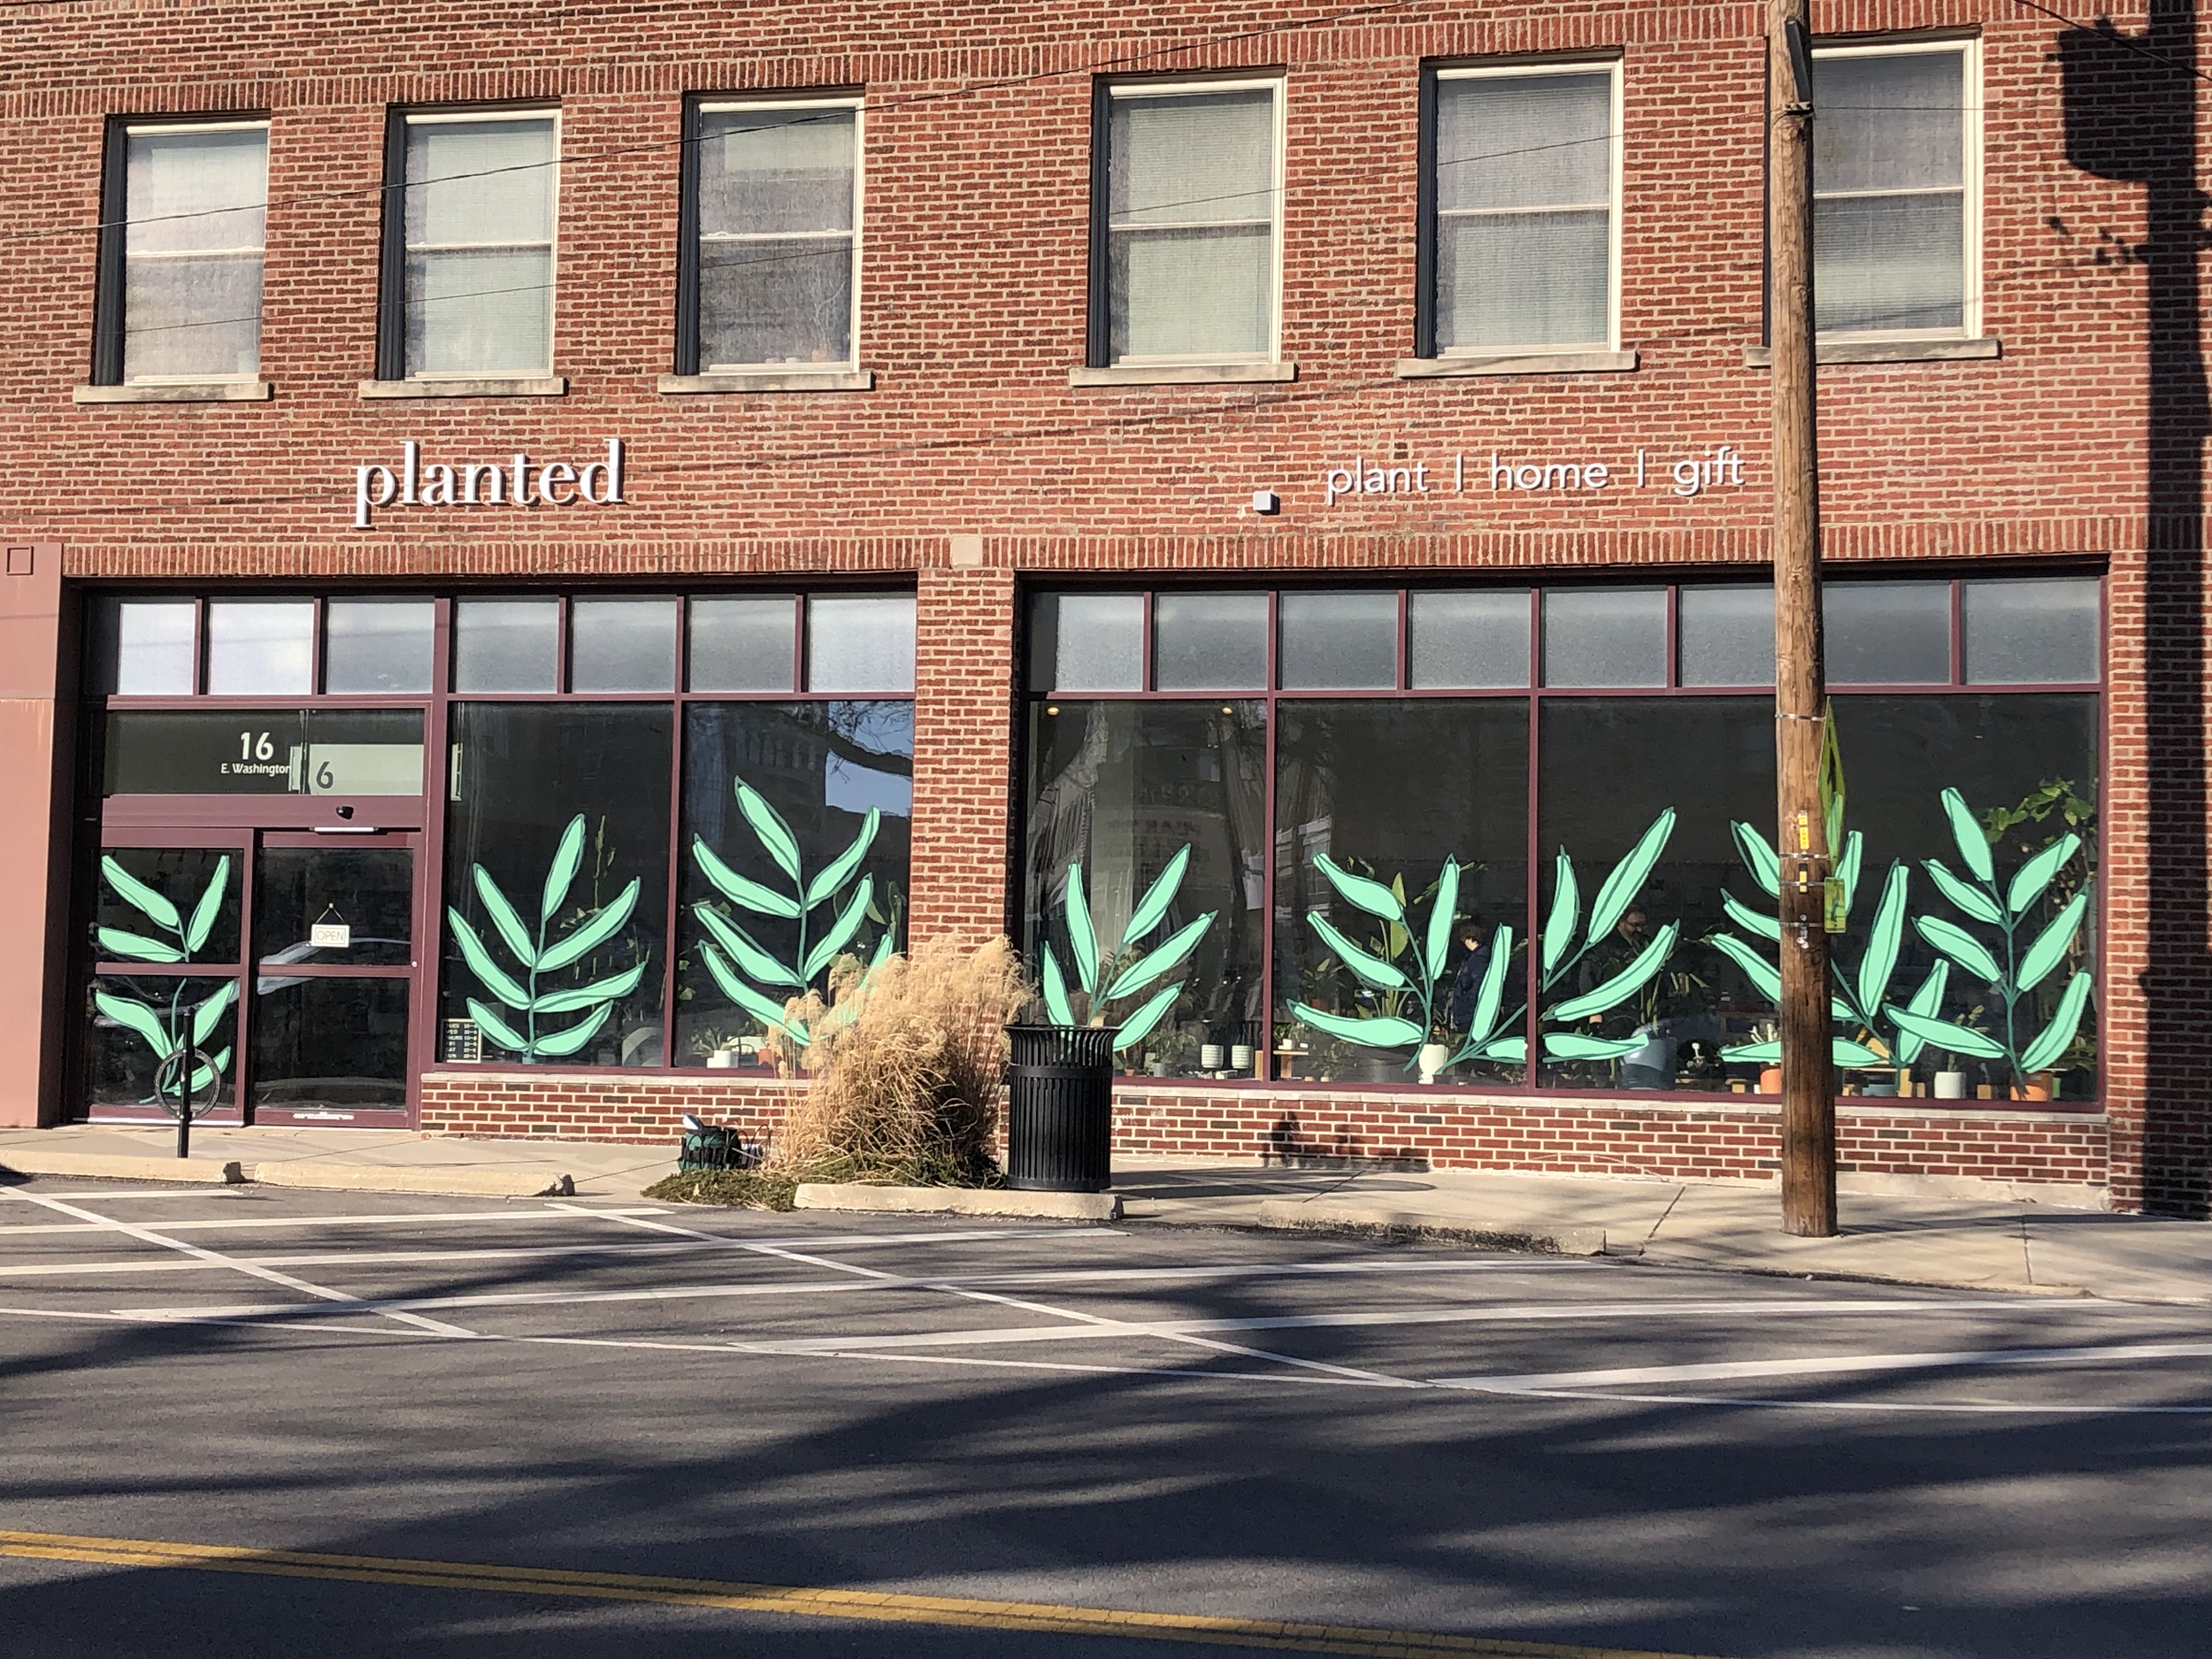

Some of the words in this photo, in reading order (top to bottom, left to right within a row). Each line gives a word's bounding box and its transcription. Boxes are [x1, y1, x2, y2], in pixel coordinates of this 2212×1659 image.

[351, 438, 624, 527] planted
[1326, 456, 1430, 505] plant
[1490, 452, 1609, 490] home
[1672, 445, 1746, 496] gift
[241, 732, 274, 760] 16
[220, 764, 230, 774] E.
[316, 930, 343, 941] OPEN
